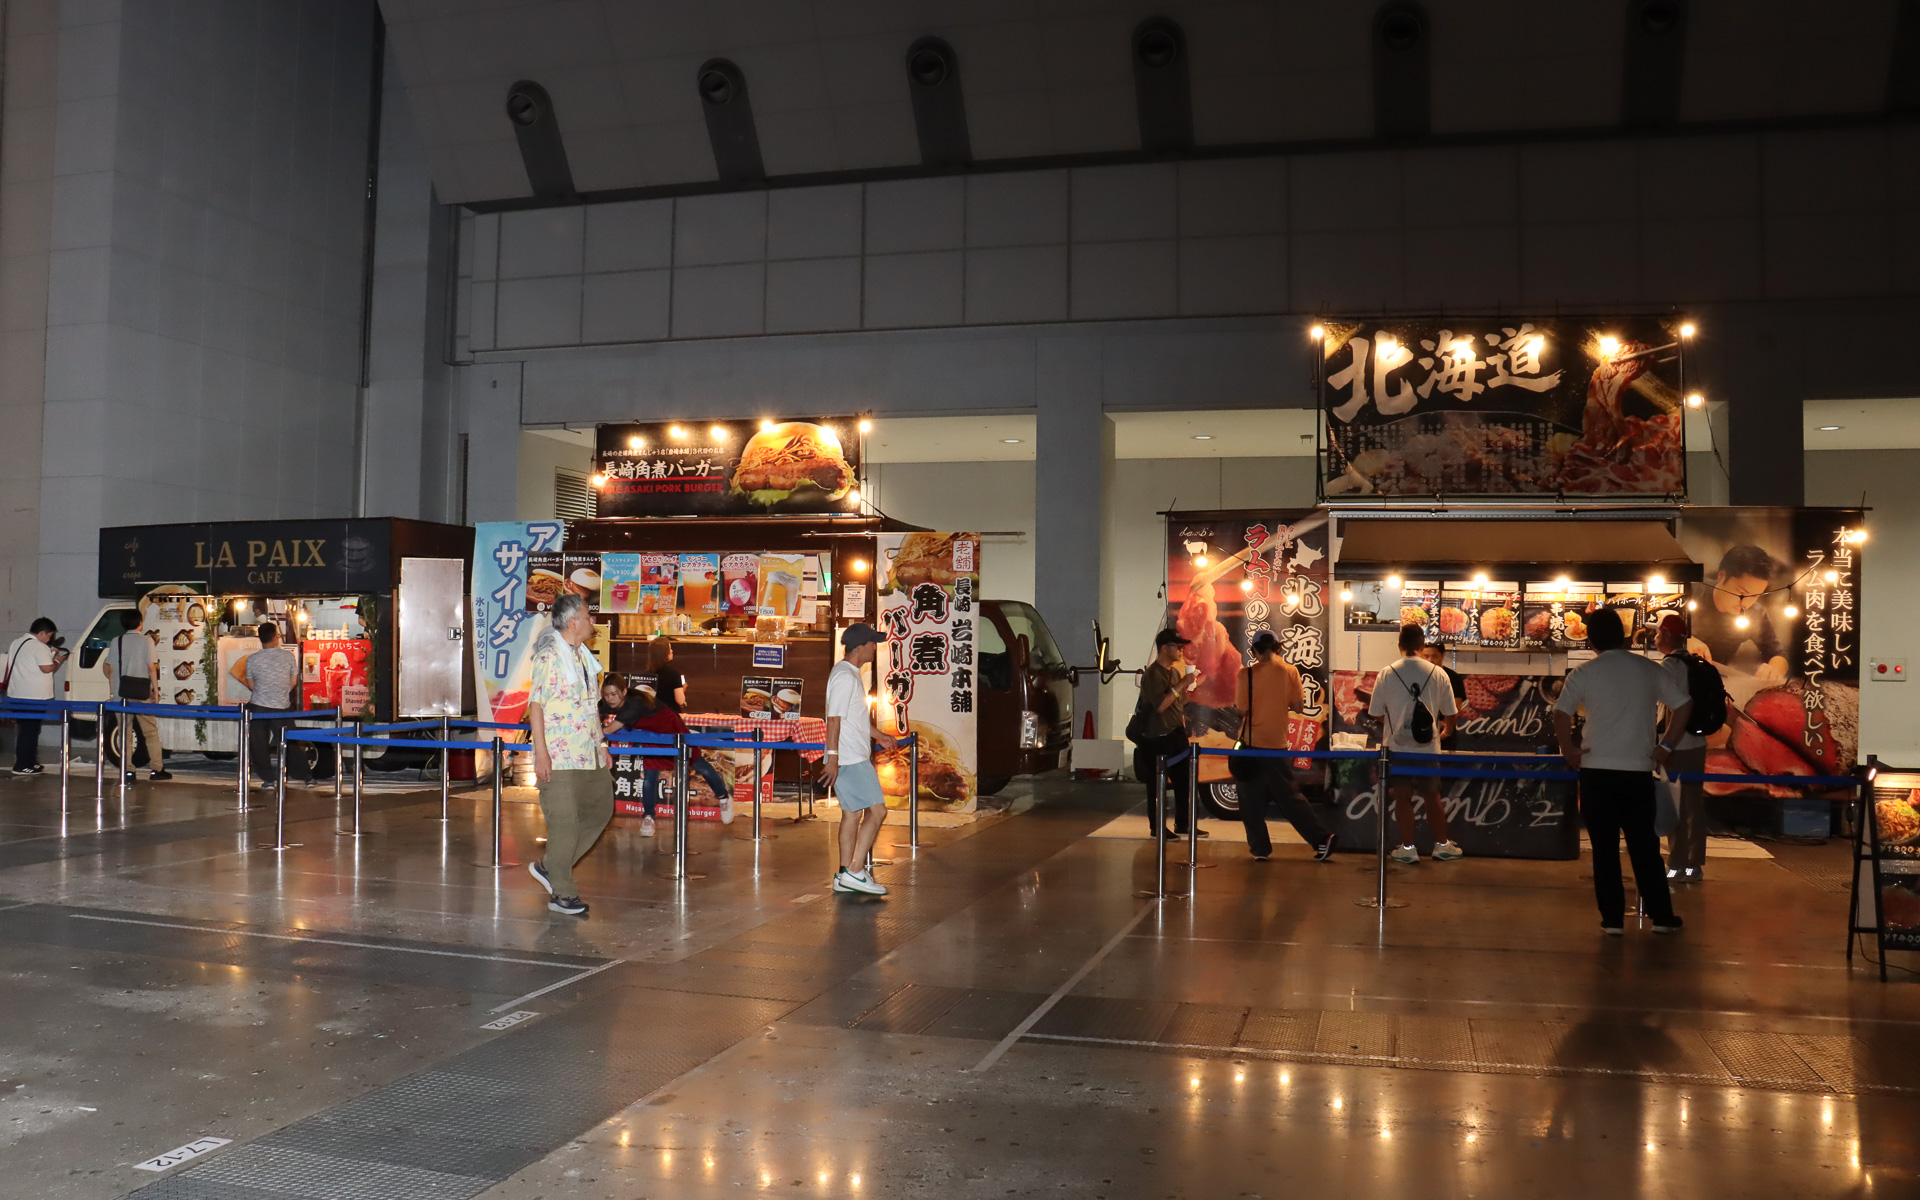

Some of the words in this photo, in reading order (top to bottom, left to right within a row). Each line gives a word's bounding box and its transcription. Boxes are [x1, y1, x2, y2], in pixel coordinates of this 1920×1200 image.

[1327, 322, 1566, 423] 北海道
[601, 458, 725, 479] 長崎角煮バーガー
[655, 484, 682, 493] PORK
[684, 483, 723, 492] BURGER
[194, 541, 237, 568] LA
[246, 539, 326, 568] PAIX
[956, 542, 971, 570] 老舗
[247, 571, 283, 584] CAFE
[491, 542, 525, 676] サイダー
[954, 578, 972, 612] 長崎
[1607, 597, 1644, 606] ハイボール
[1648, 595, 1686, 609] 缶ビール
[1830, 526, 1853, 670] 本当に美味しい
[306, 629, 349, 640] CREPE
[911, 583, 948, 672] 角煮
[1510, 592, 1521, 647] チャンピオン
[1549, 602, 1565, 642] 串焼き
[318, 642, 360, 650] けずりいちご
[1280, 575, 1324, 717] 北海道
[1803, 549, 1826, 757] ラム肉を食べて欲しい。
[882, 607, 911, 733] バーガー
[950, 619, 972, 713] 岩崎本舗
[658, 806, 675, 815] Pork
[146, 1139, 221, 1167] L7-12
